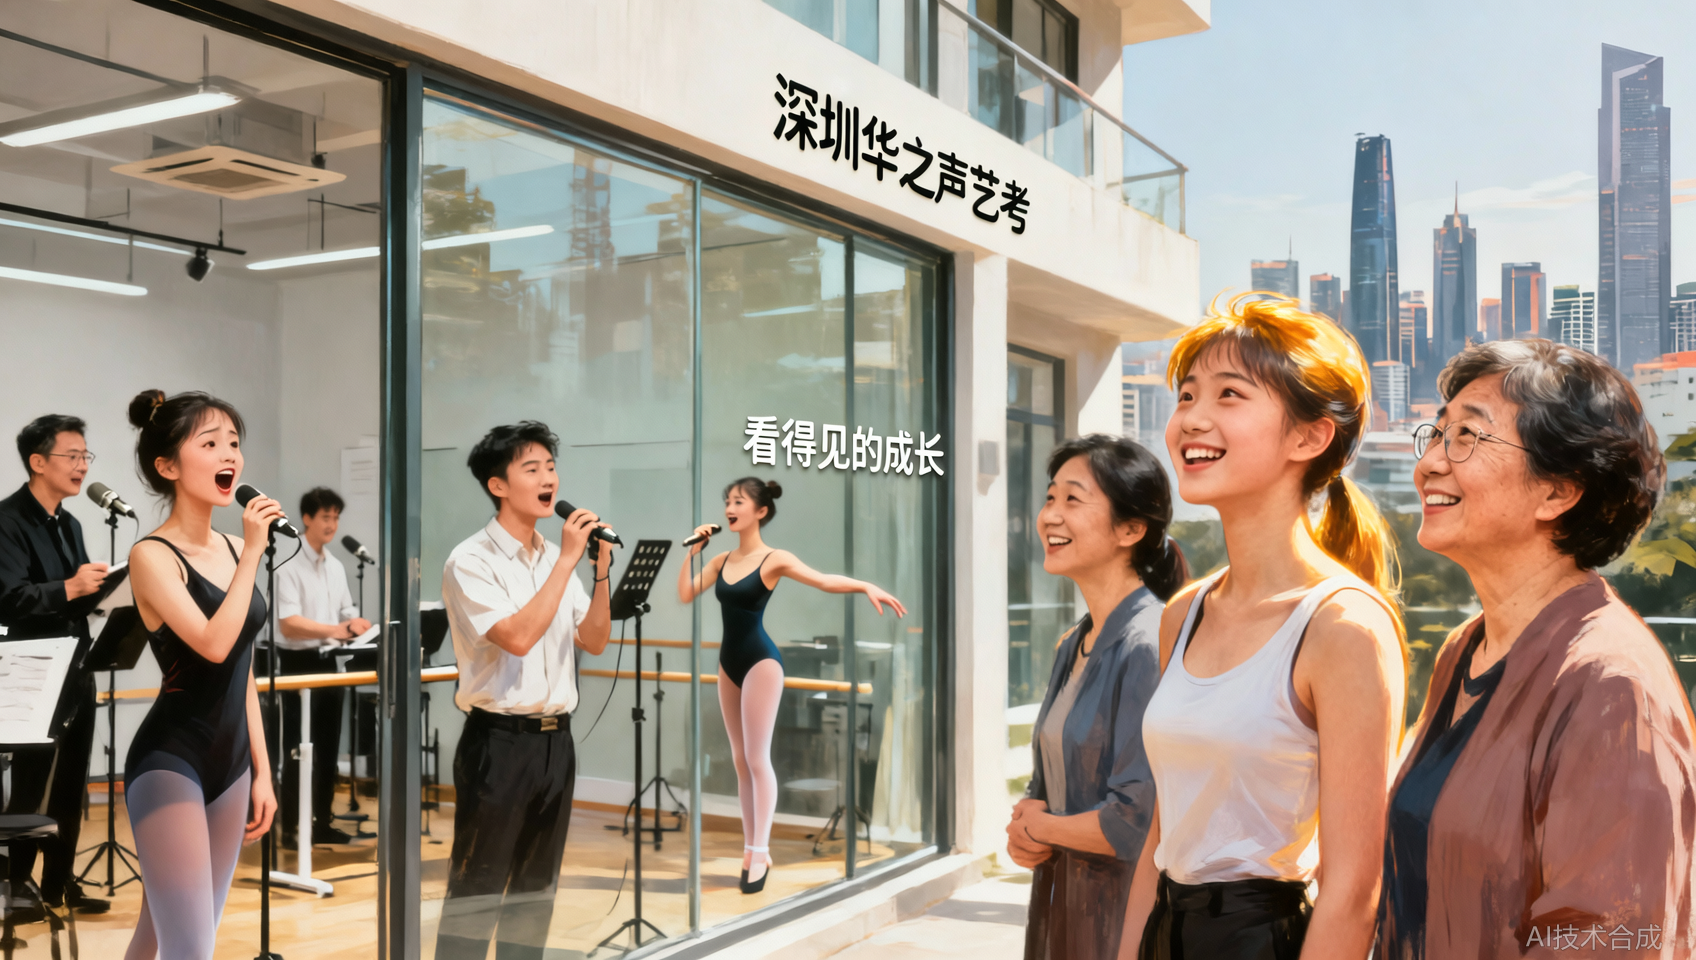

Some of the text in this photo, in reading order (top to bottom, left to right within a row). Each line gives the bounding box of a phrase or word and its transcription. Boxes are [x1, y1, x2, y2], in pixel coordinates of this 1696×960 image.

[773, 73, 1030, 235] 深圳华之声艺考
[743, 415, 945, 477] 看得见的成长
